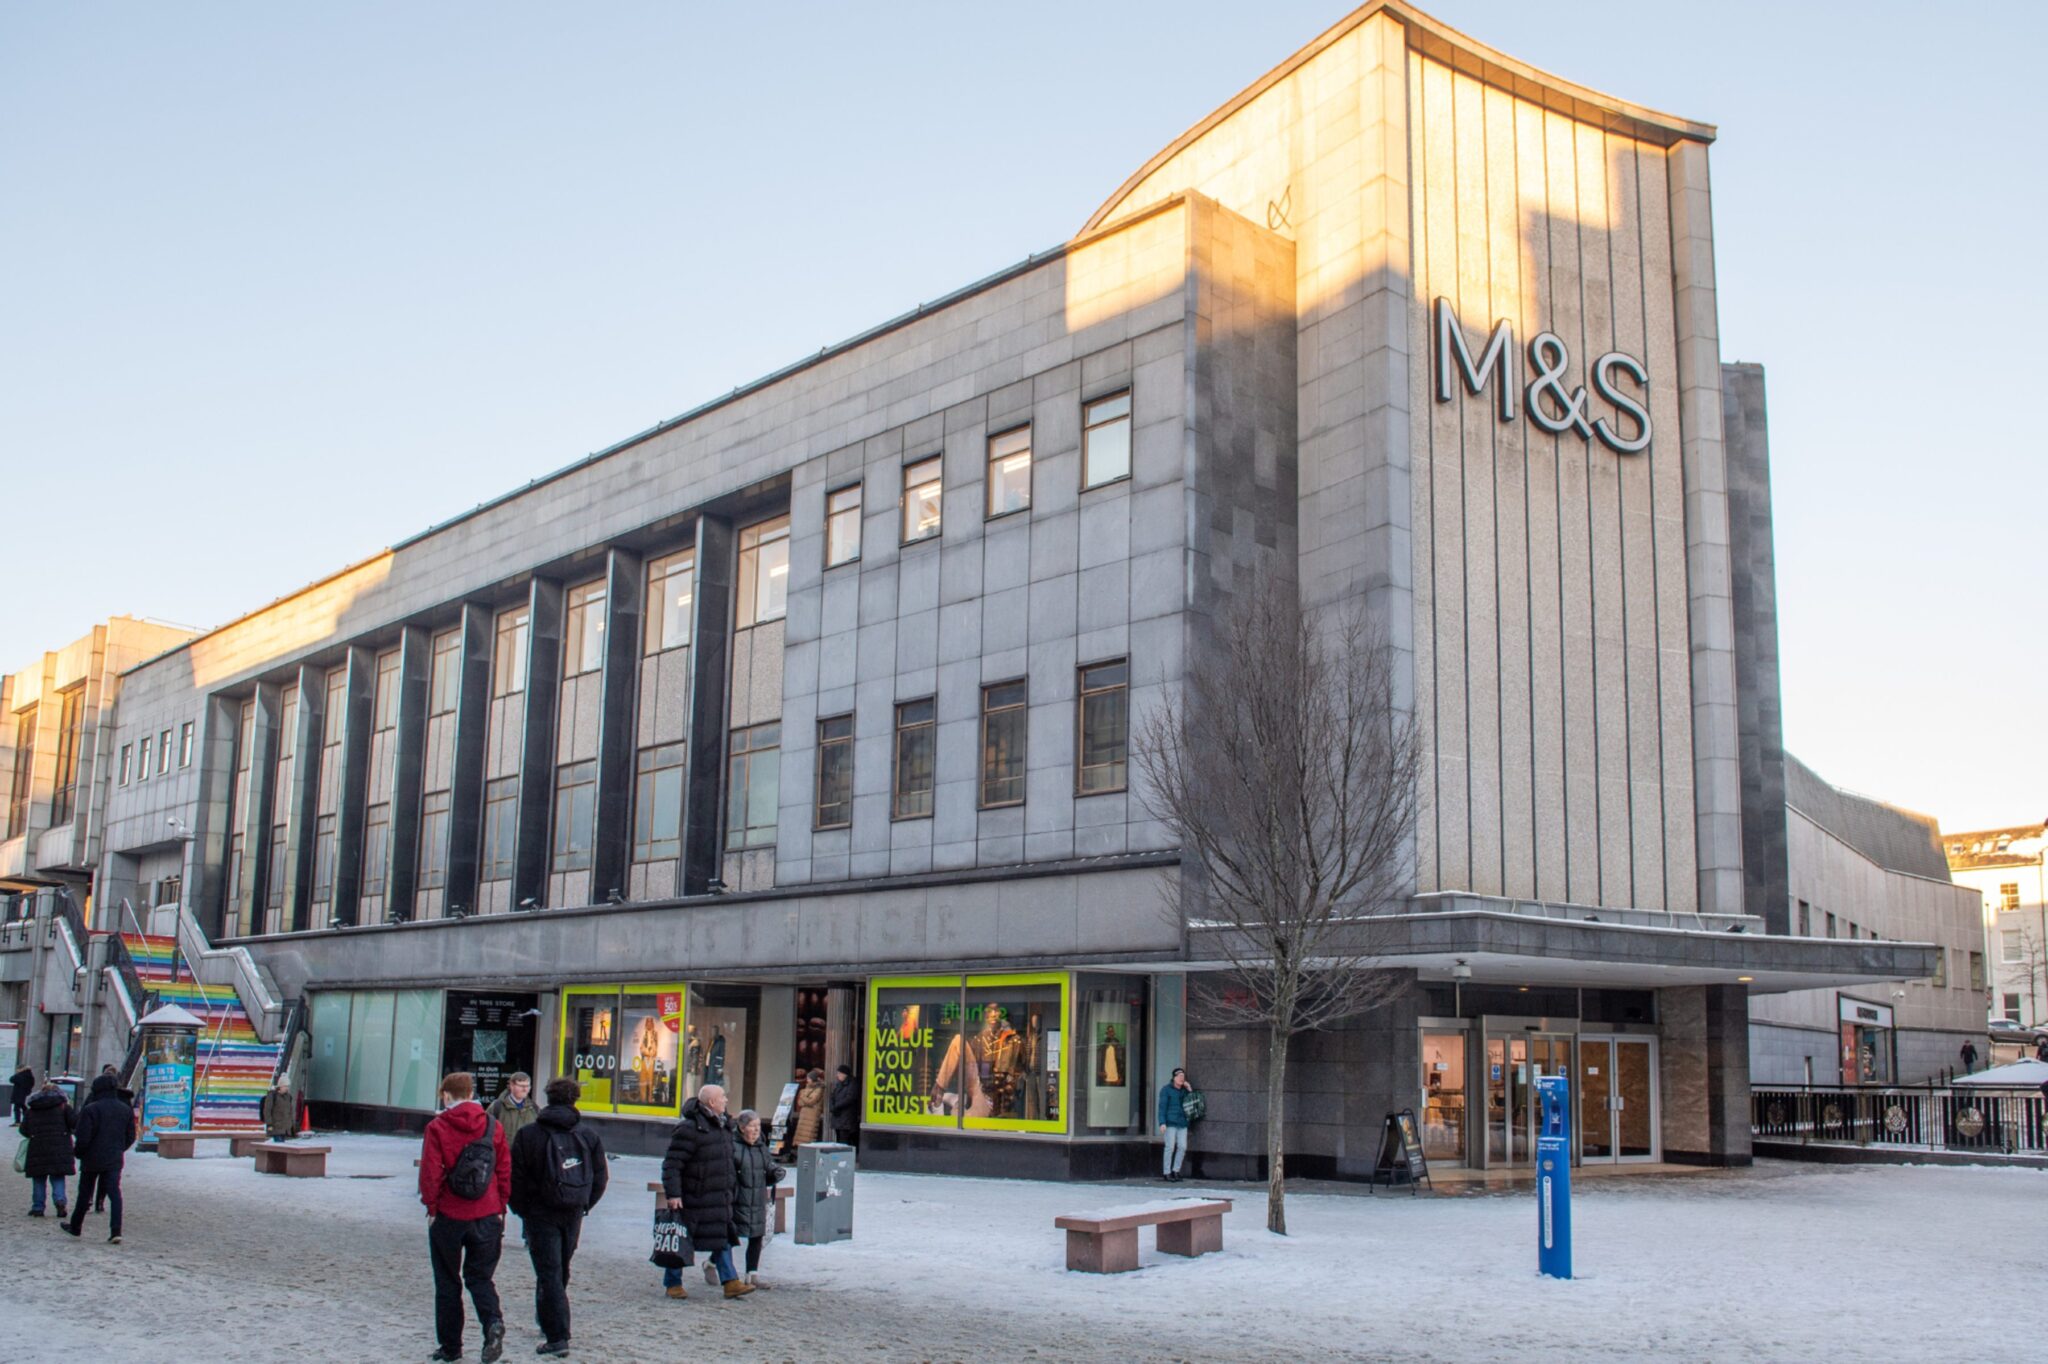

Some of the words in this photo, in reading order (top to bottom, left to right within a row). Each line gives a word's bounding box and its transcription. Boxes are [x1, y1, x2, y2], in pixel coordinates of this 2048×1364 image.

[1434, 296, 1652, 452] M&S
[876, 1028, 934, 1048] VALUE
[574, 1053, 616, 1070] GOOD
[623, 1055, 664, 1071] OVE
[875, 1050, 913, 1070] YOU
[874, 1072, 913, 1093] CAN
[873, 1094, 932, 1115] TRUST
[654, 1234, 680, 1252] BAG
